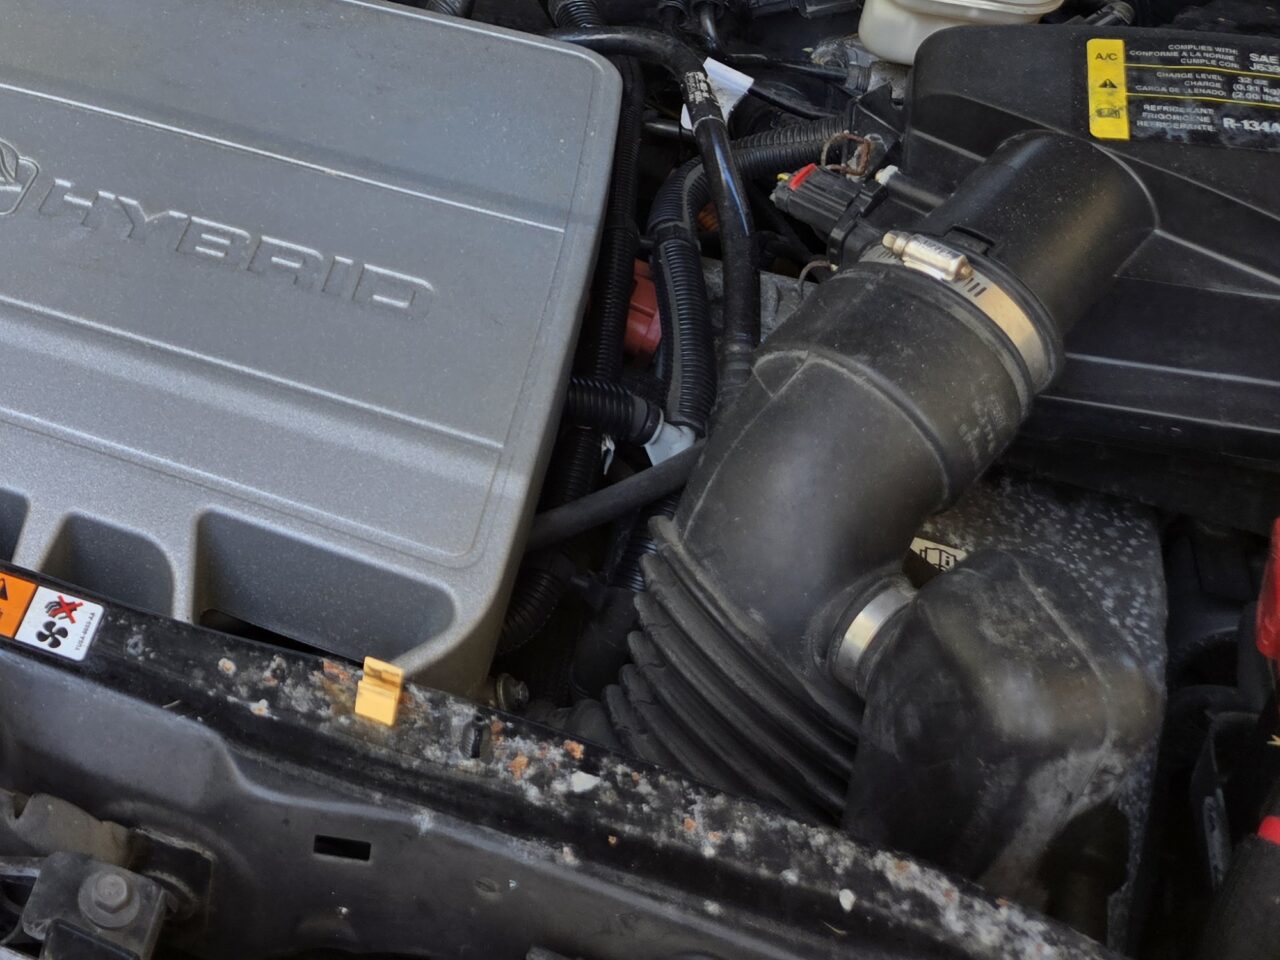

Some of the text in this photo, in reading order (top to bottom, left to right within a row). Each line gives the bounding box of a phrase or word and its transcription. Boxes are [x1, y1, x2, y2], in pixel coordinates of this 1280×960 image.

[1168, 44, 1238, 55] COMPLIES WITH:
[1095, 53, 1118, 61] A/C
[1129, 50, 1179, 58] CONFORME
[1180, 58, 1218, 66] CUMPLE
[1249, 53, 1280, 64] SAE
[1156, 71, 1193, 79] CHARGE
[1237, 76, 1253, 84] 32
[1135, 85, 1167, 93] CARGA
[38, 178, 436, 321] HYBRID
